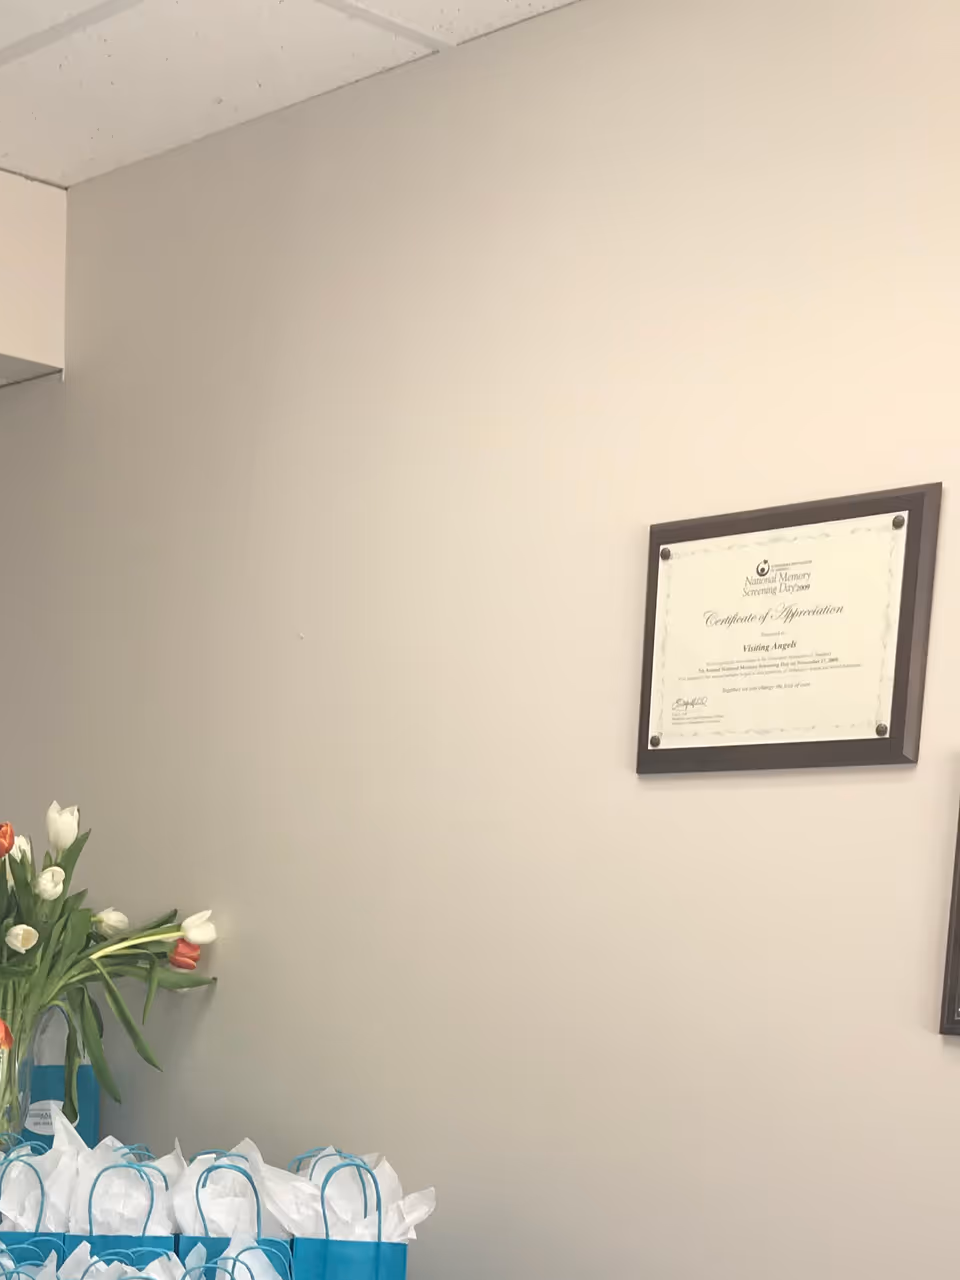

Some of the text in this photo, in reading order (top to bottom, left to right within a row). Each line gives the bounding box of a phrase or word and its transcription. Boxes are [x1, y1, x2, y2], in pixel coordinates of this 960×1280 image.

[745, 571, 811, 587] National Memory
[742, 584, 778, 597] Screening
[703, 602, 844, 628] Certificate of Appreciation
[743, 640, 797, 652] Visiting Angels
